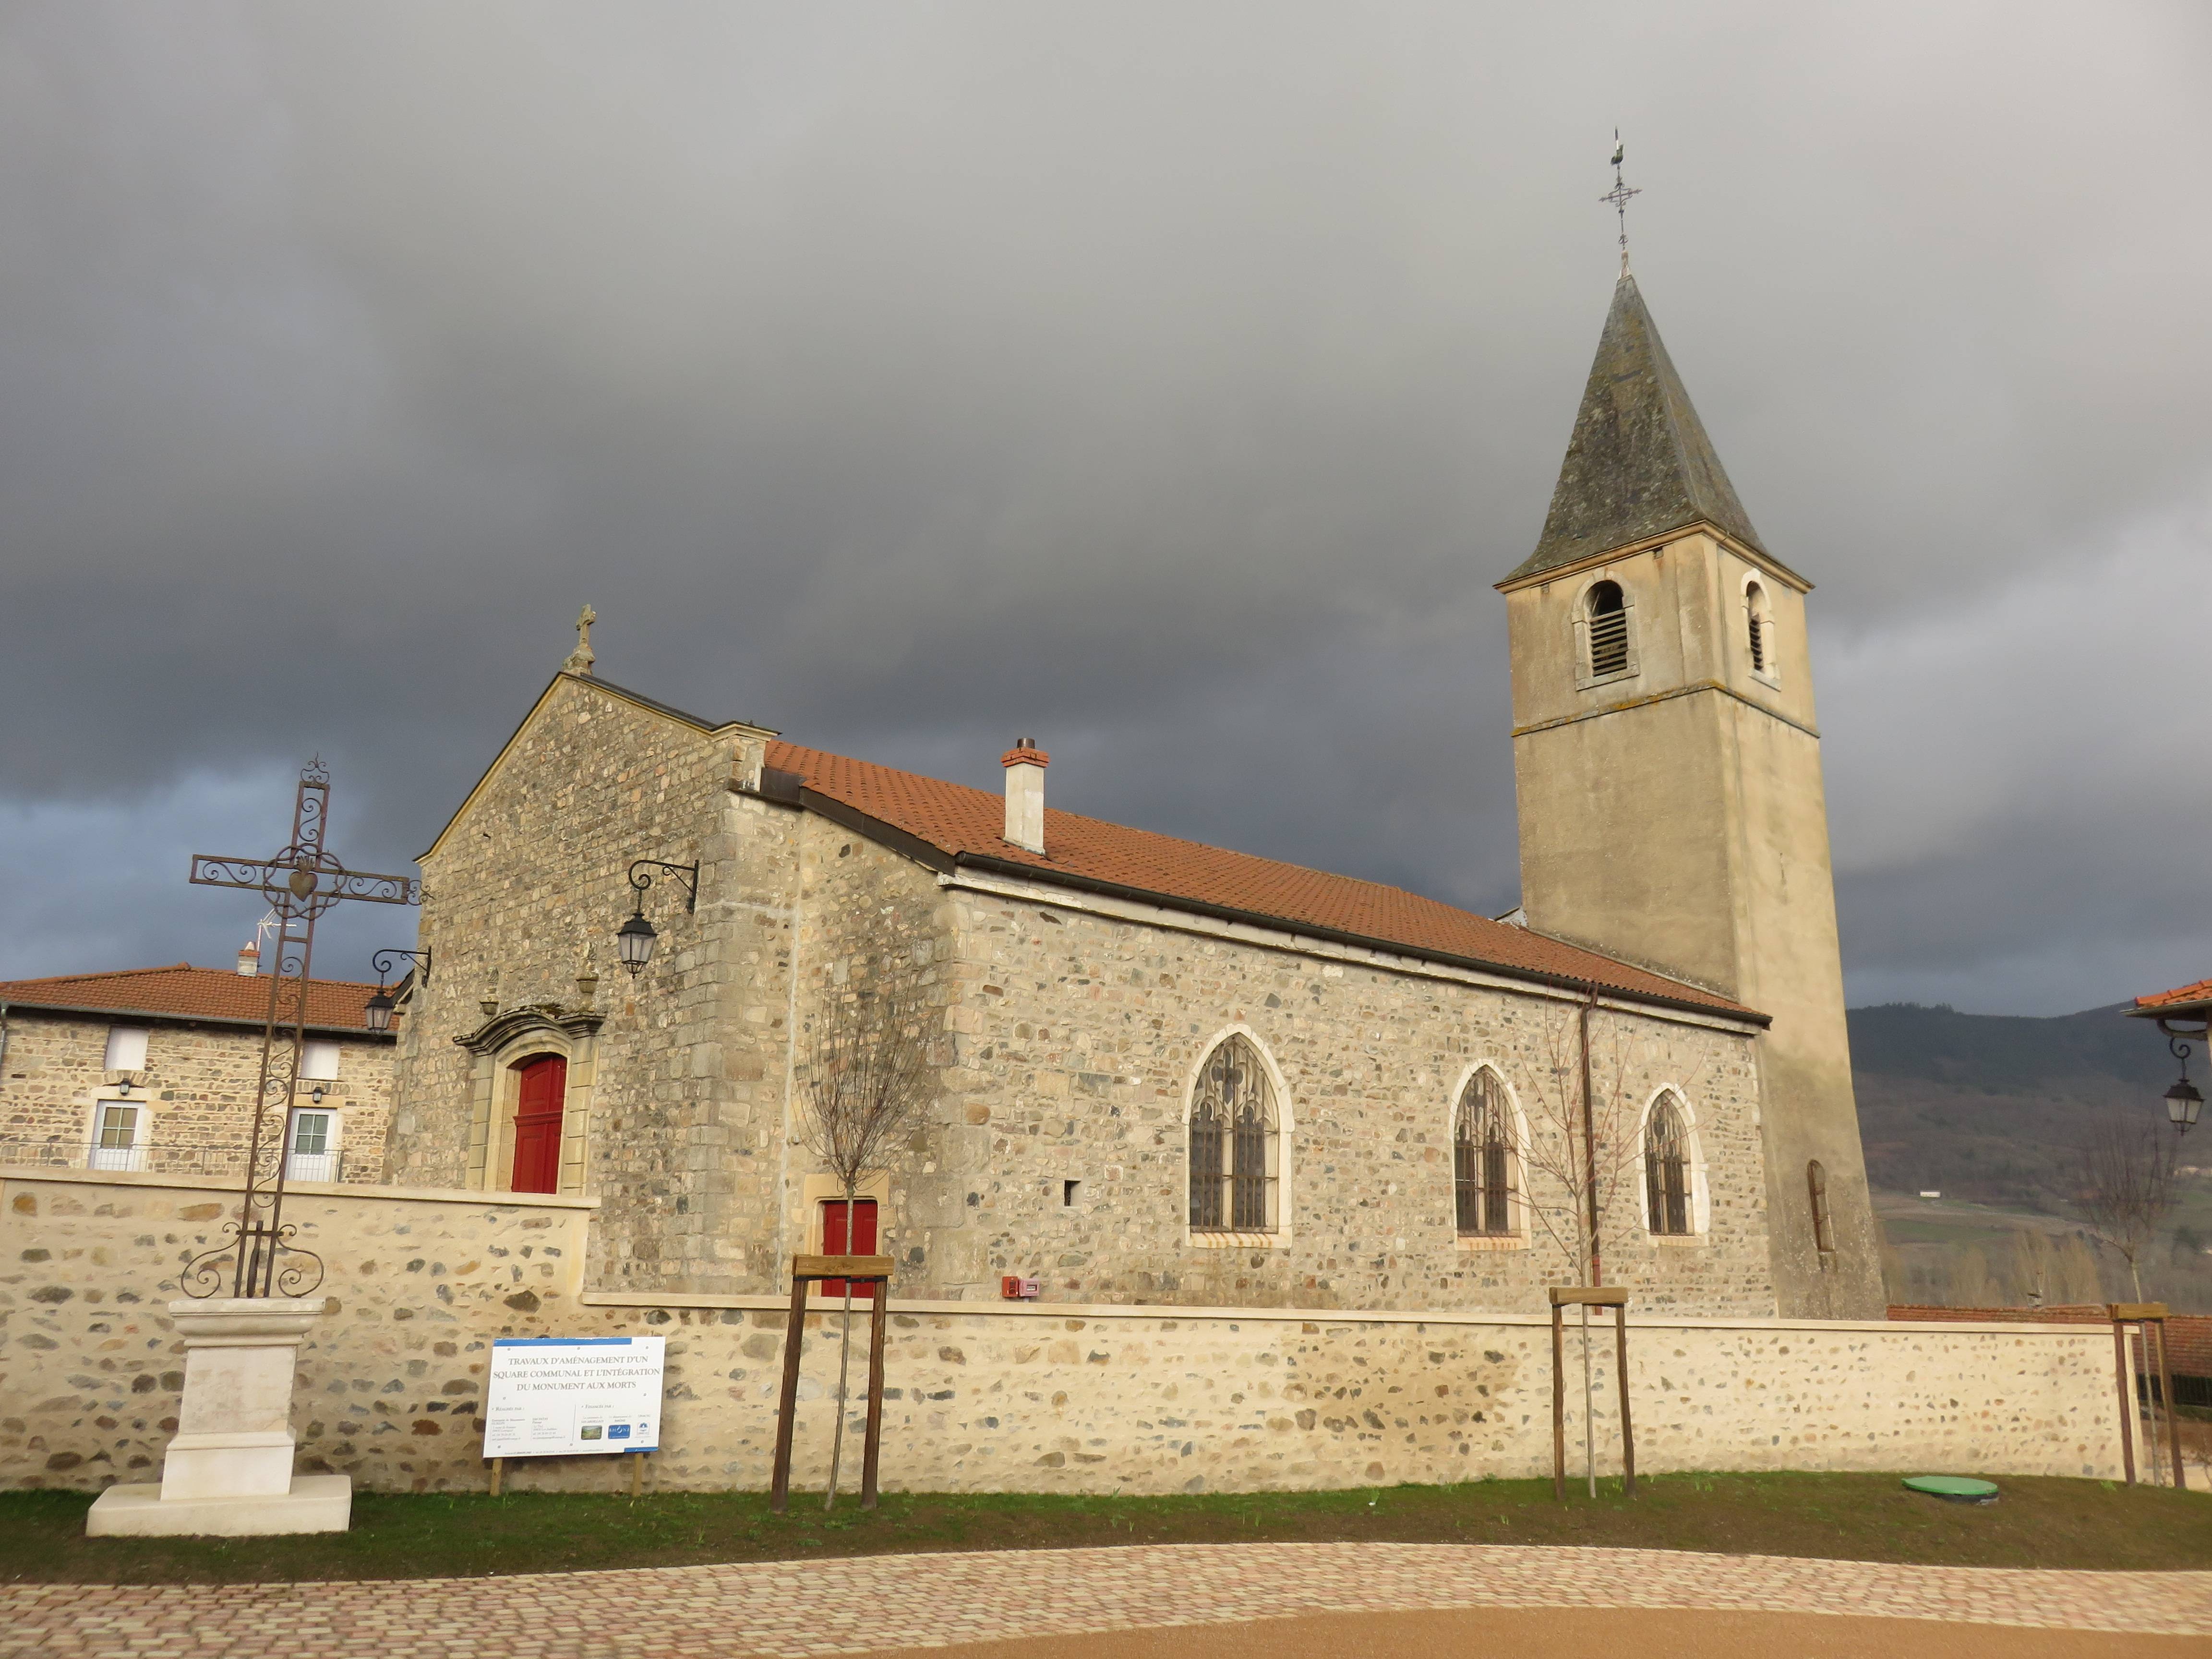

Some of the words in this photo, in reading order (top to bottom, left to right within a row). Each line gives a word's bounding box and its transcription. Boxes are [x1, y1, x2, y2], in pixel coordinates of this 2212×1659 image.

[551, 1356, 625, 1364] D'AMÉNAGEMENT
[493, 1371, 528, 1379] SQUARE
[529, 1370, 582, 1378] COMMUNAL
[596, 1367, 661, 1376] L'INTÉGRATION
